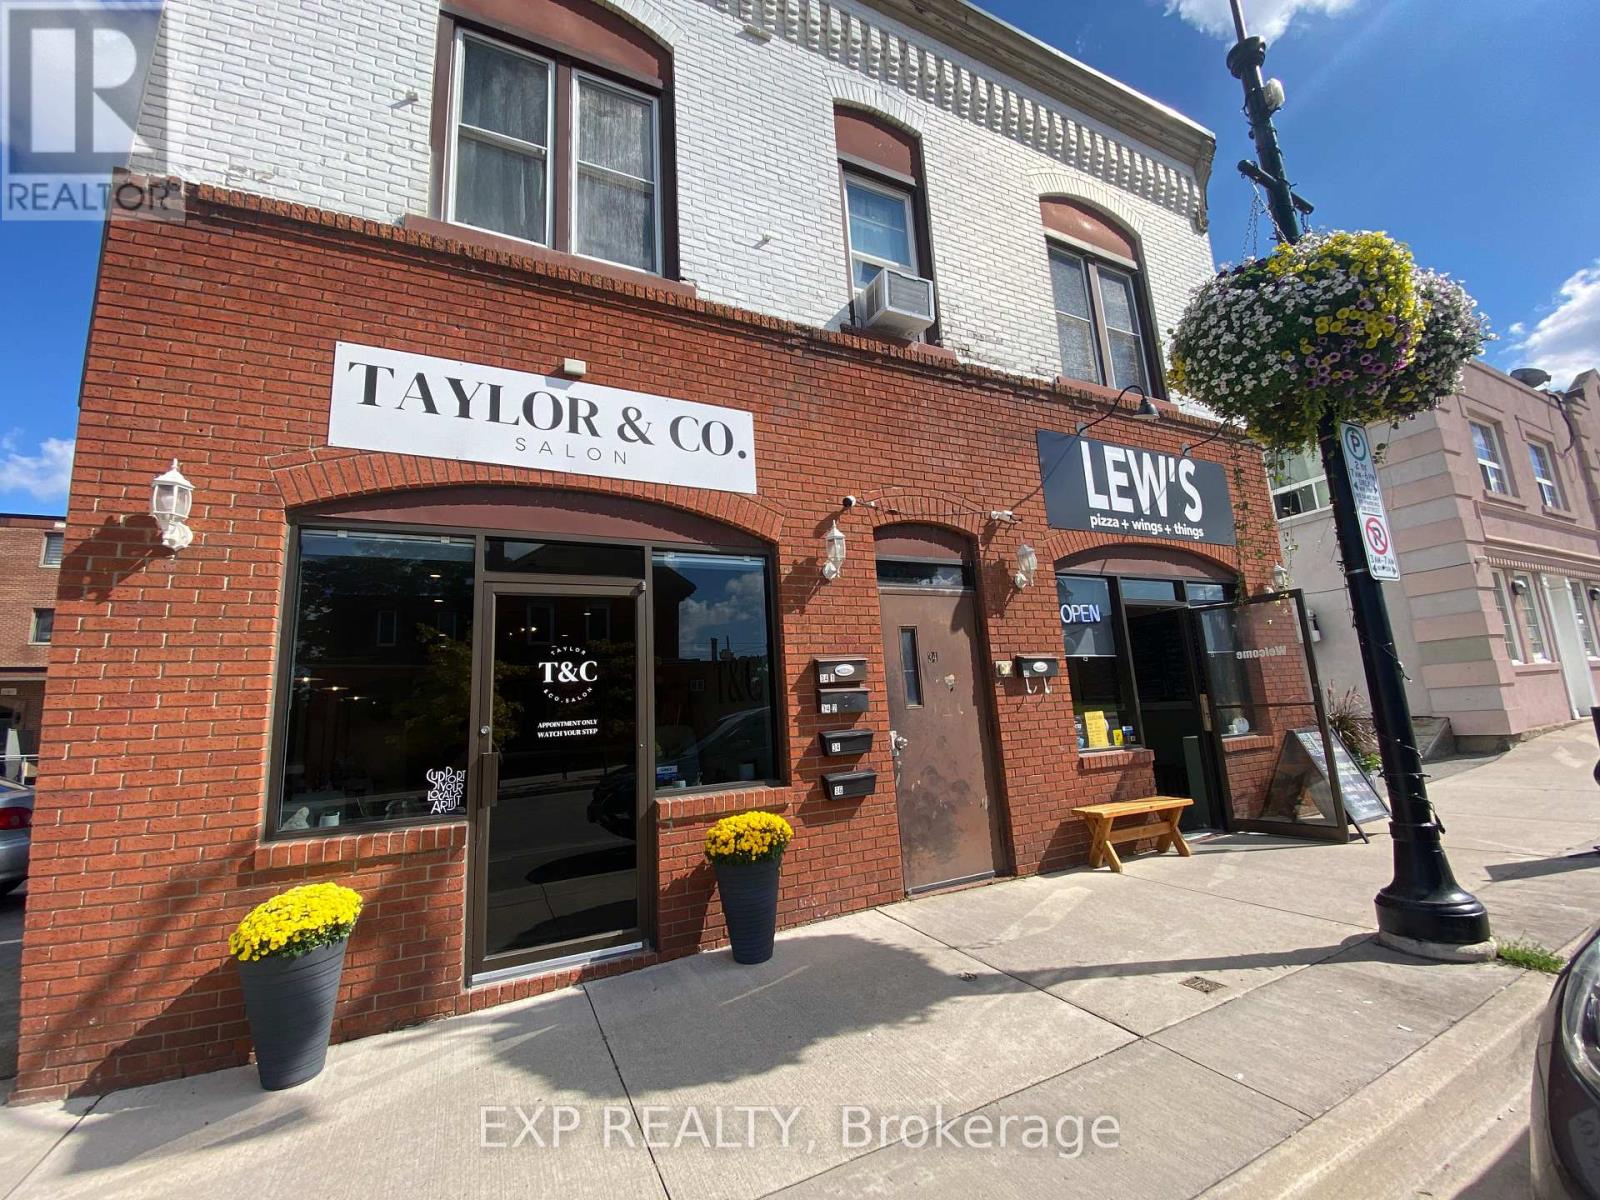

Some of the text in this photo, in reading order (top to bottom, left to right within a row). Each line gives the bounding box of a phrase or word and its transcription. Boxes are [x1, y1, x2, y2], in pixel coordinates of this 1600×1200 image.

[348, 362, 747, 460] TAYLOR & CO.
[516, 437, 627, 465] SALON
[1080, 440, 1203, 523] LEW'S
[1090, 514, 1205, 540] pizza + wings + things
[1060, 604, 1101, 623] OPEN
[550, 646, 586, 656] TAYLOR
[538, 660, 598, 683] T&C
[565, 686, 593, 704] SALON
[537, 720, 581, 729] APPOINTMENT
[537, 730, 563, 739] WATCH
[563, 729, 581, 737] YOUR
[426, 766, 467, 790] SUPPORT
[427, 790, 454, 801] LOCAL
[440, 782, 464, 795] YOUR
[430, 792, 462, 814] ARTIST
